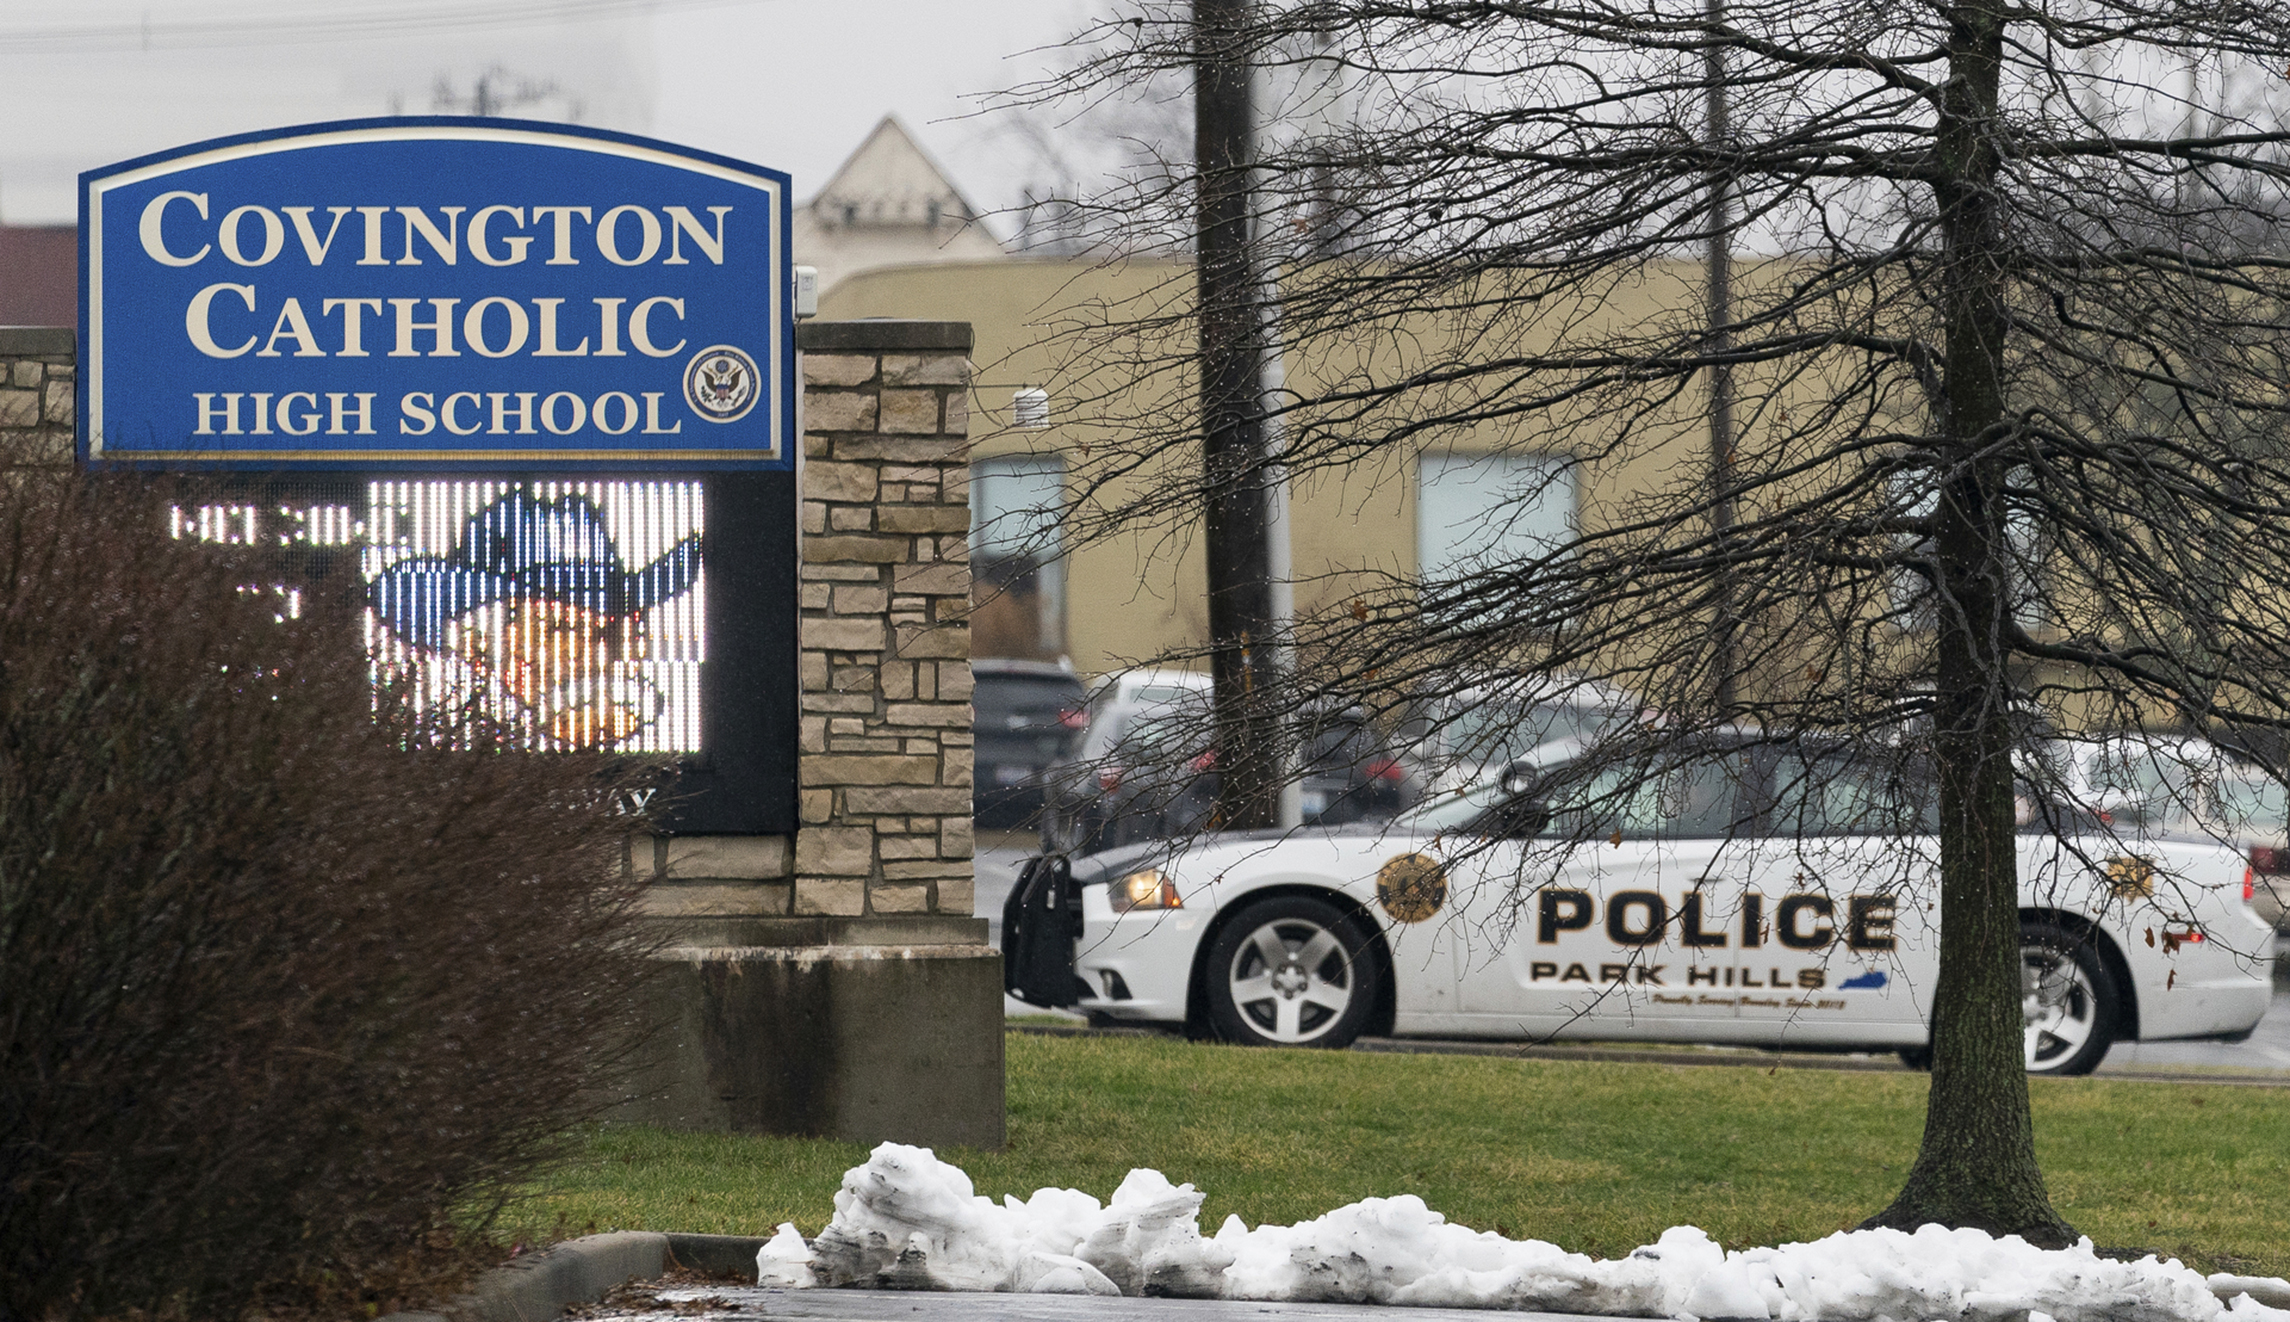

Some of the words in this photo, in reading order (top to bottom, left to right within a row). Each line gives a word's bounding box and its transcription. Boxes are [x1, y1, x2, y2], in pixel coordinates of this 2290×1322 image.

[139, 191, 733, 267] COVINGTON
[185, 283, 687, 359] CATHOLIC
[193, 392, 377, 436] HIGH
[400, 392, 682, 436] SCHOOL
[1537, 887, 1898, 951] POLICE
[1530, 961, 1667, 986] PARK
[1688, 965, 1826, 989] HILLS
